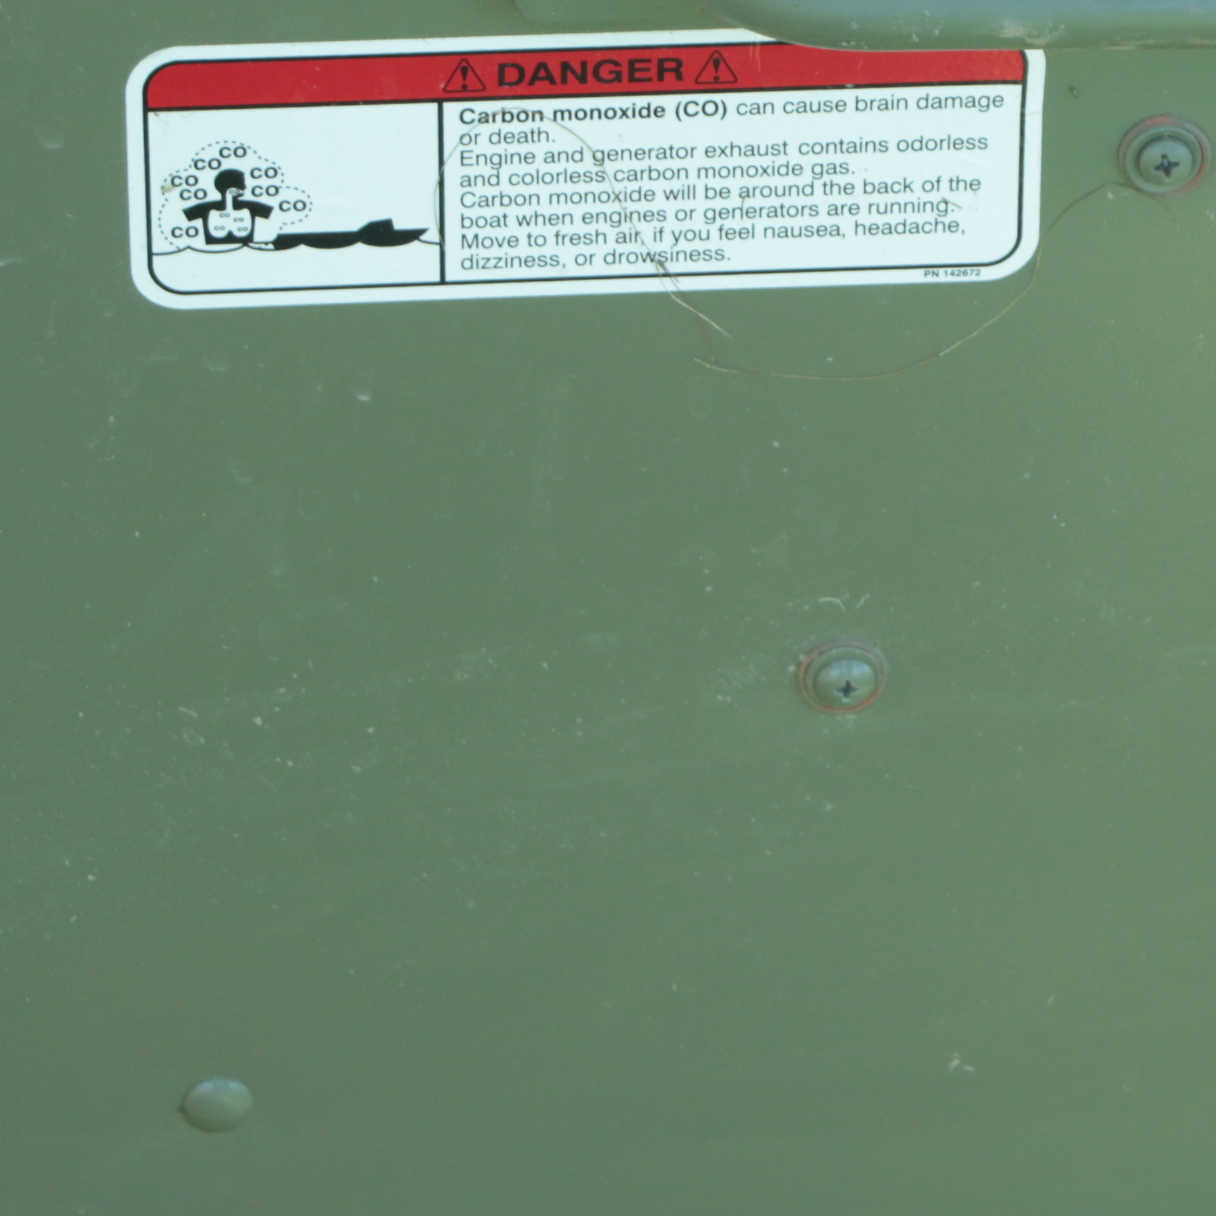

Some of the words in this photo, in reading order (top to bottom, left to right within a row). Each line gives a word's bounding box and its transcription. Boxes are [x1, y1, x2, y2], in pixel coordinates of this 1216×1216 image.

[497, 57, 684, 87] DANGER
[459, 107, 544, 125] Carbon
[553, 102, 666, 122] monoxide
[675, 100, 727, 121] (CO)
[736, 100, 775, 116] can
[782, 98, 847, 114] cause
[855, 94, 908, 112] brain
[916, 93, 1004, 112] damage
[459, 131, 481, 146] or
[489, 127, 556, 145] death.
[219, 146, 247, 158] CO
[460, 148, 536, 169] Engine
[543, 146, 584, 164] and
[592, 144, 698, 166] generator
[704, 139, 788, 159] exhaust
[798, 137, 889, 156] contains
[896, 135, 988, 153] odorless
[194, 158, 222, 170] CO
[250, 167, 278, 179] CO
[460, 170, 500, 188] and
[508, 167, 606, 186] colorless
[613, 165, 689, 182] carbon
[697, 161, 803, 180] monoxide
[811, 162, 855, 179] gas.
[171, 175, 198, 187] CO
[180, 188, 207, 200] CO
[251, 185, 279, 197] CO
[460, 189, 540, 208] Carbon
[549, 186, 656, 205] monoxide
[663, 184, 696, 201] will
[705, 182, 731, 200] be
[739, 180, 814, 199] around
[822, 179, 855, 196] the
[863, 177, 914, 195] back
[921, 176, 942, 193] of
[948, 175, 981, 192] the
[279, 200, 306, 212] CO
[461, 212, 508, 229] boat
[516, 211, 573, 227] when
[582, 207, 667, 228] engines
[675, 208, 696, 221] or
[704, 201, 819, 224] generators
[827, 201, 860, 217] are
[868, 198, 955, 217] running.
[171, 226, 199, 238] CO
[461, 234, 519, 250] Move
[527, 233, 546, 247] to
[554, 229, 607, 246] fresh
[615, 228, 644, 245] air,
[653, 226, 665, 243] if
[671, 228, 710, 246] you
[718, 224, 755, 241] feel
[763, 223, 846, 239] nausea,
[854, 217, 965, 236] headache,
[461, 253, 566, 271] dizziness,
[574, 252, 596, 267] or
[603, 247, 731, 265] drowsiness.
[924, 269, 939, 278] PN
[943, 268, 981, 278] 142672
